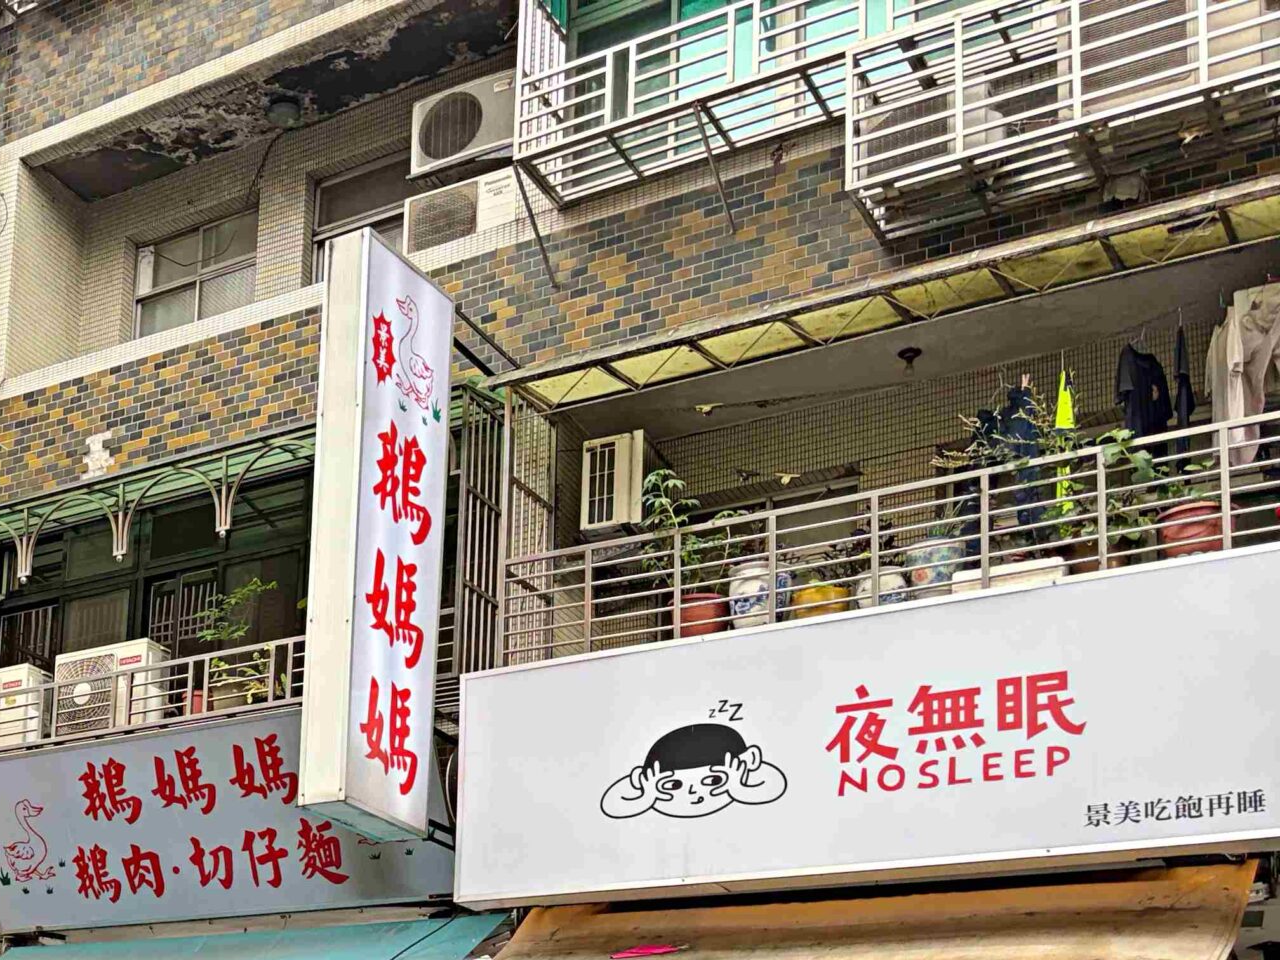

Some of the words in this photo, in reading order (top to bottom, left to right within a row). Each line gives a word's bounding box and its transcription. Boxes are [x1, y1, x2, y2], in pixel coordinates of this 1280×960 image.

[359, 418, 433, 796] 鵝媽媽
[825, 670, 1088, 764] 夜無眠
[77, 733, 299, 826] 鵝媽媽
[1083, 789, 1266, 829] 景美吃飽再睡
